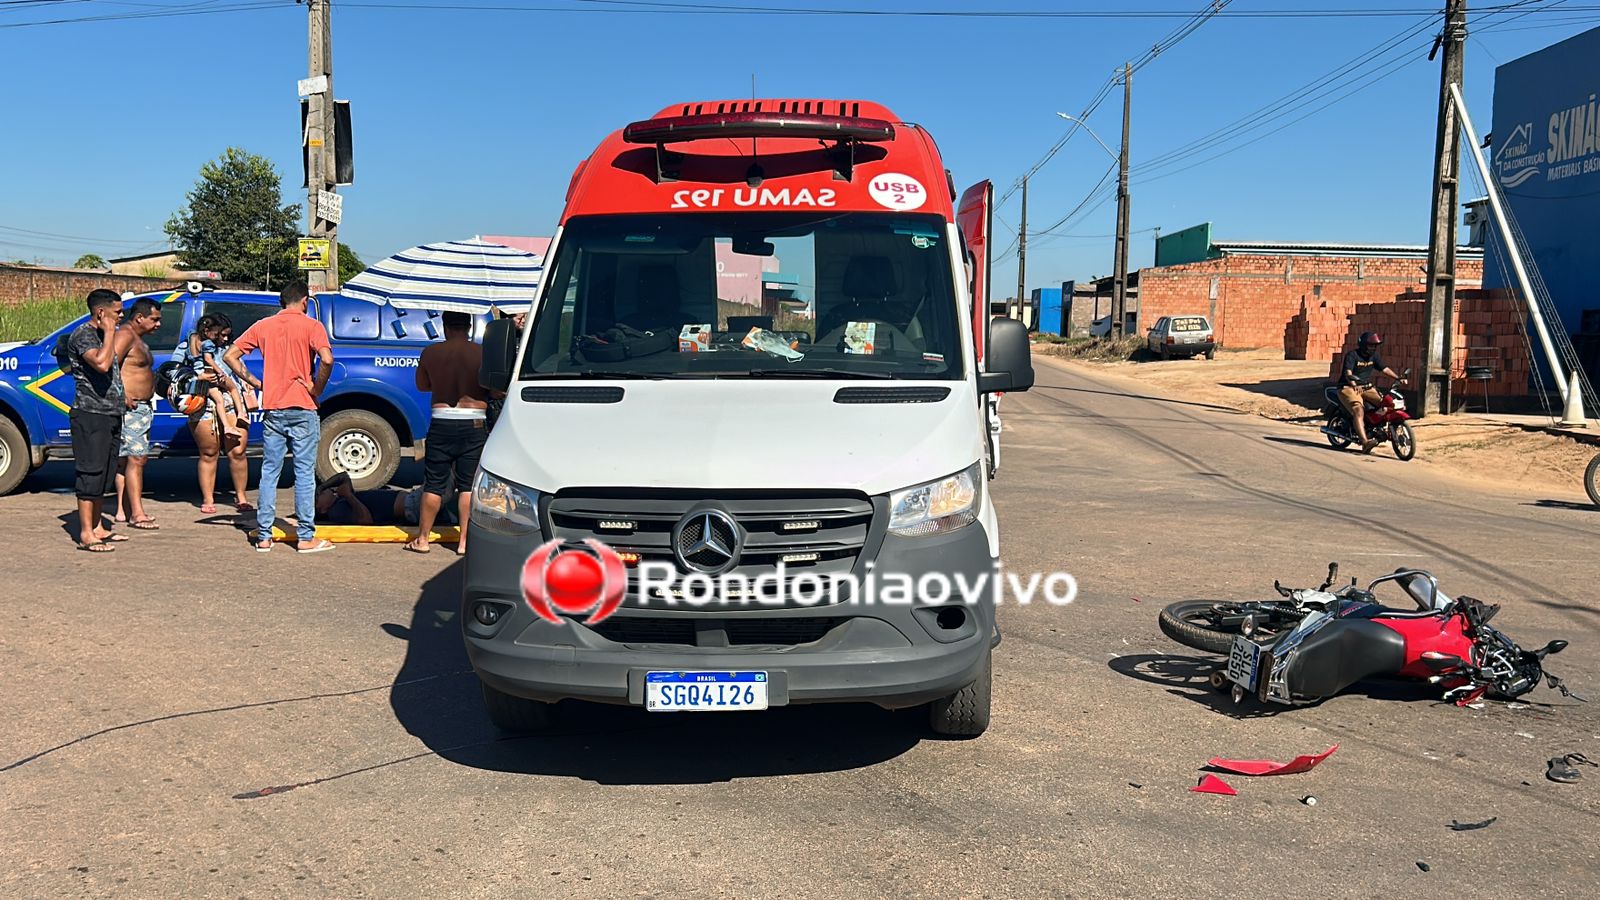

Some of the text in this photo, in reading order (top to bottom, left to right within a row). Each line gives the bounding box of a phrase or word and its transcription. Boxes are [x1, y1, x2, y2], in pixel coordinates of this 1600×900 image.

[1503, 151, 1545, 171] DA CONSTRUÇÃO
[1547, 162, 1581, 181] MATERIAIS
[874, 181, 920, 194] USB
[894, 194, 906, 204] 2
[375, 357, 420, 367] RADIOPA
[1230, 643, 1243, 680] 2G50
[1240, 651, 1252, 677] SLL
[660, 684, 755, 706] SGQ4I26
